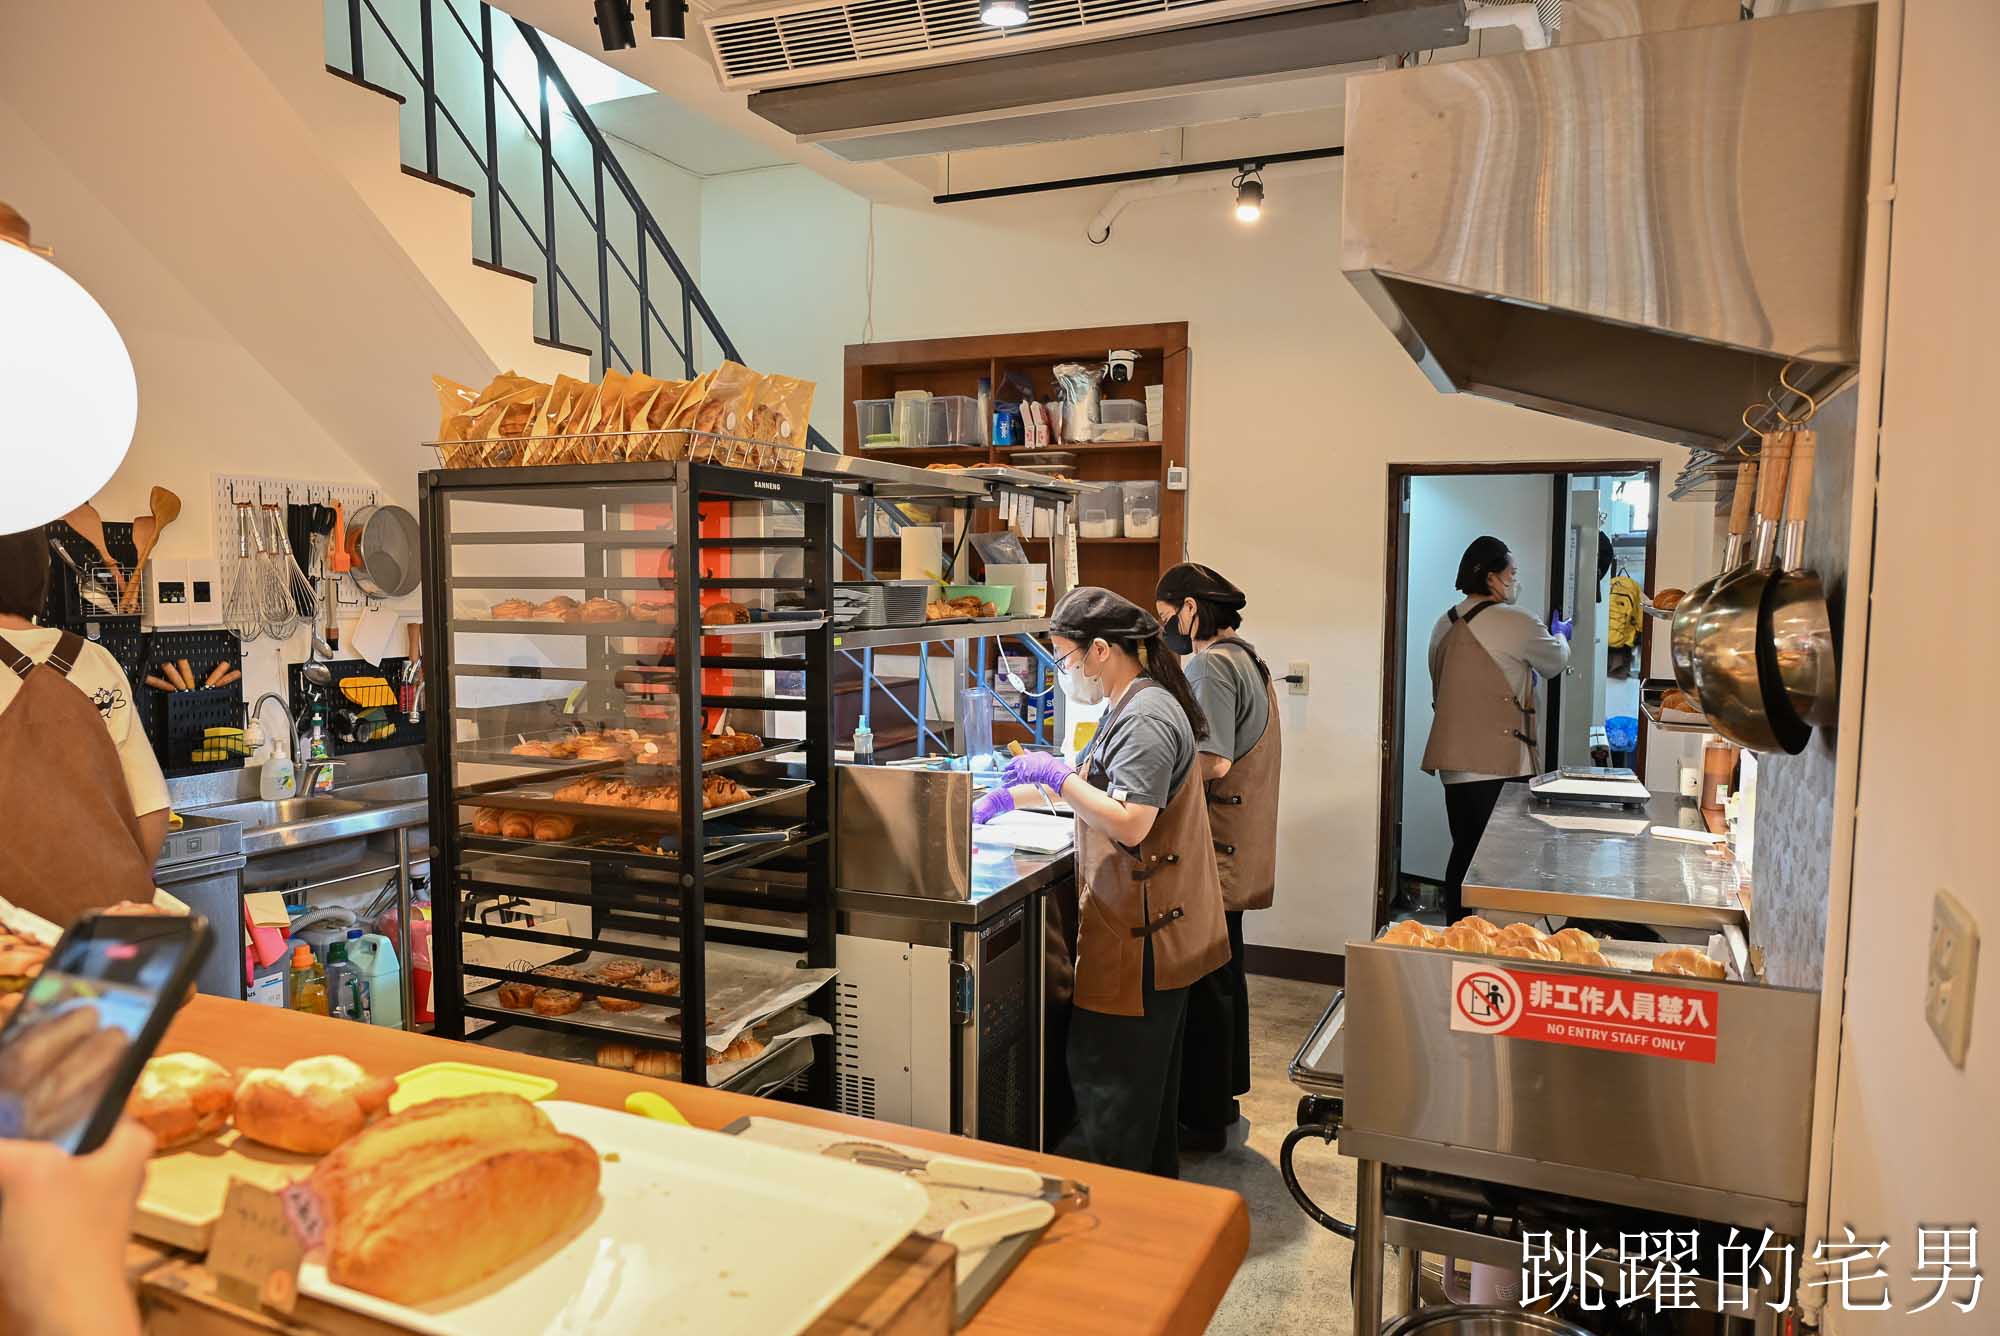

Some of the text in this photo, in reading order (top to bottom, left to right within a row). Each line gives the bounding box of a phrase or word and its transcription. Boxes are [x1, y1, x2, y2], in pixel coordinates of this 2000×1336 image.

[754, 481, 781, 491] SANNENG
[1529, 980, 1710, 1029] 非工作人員禁入
[1547, 1023, 1686, 1052] NO ENTRY STAFF ONLY
